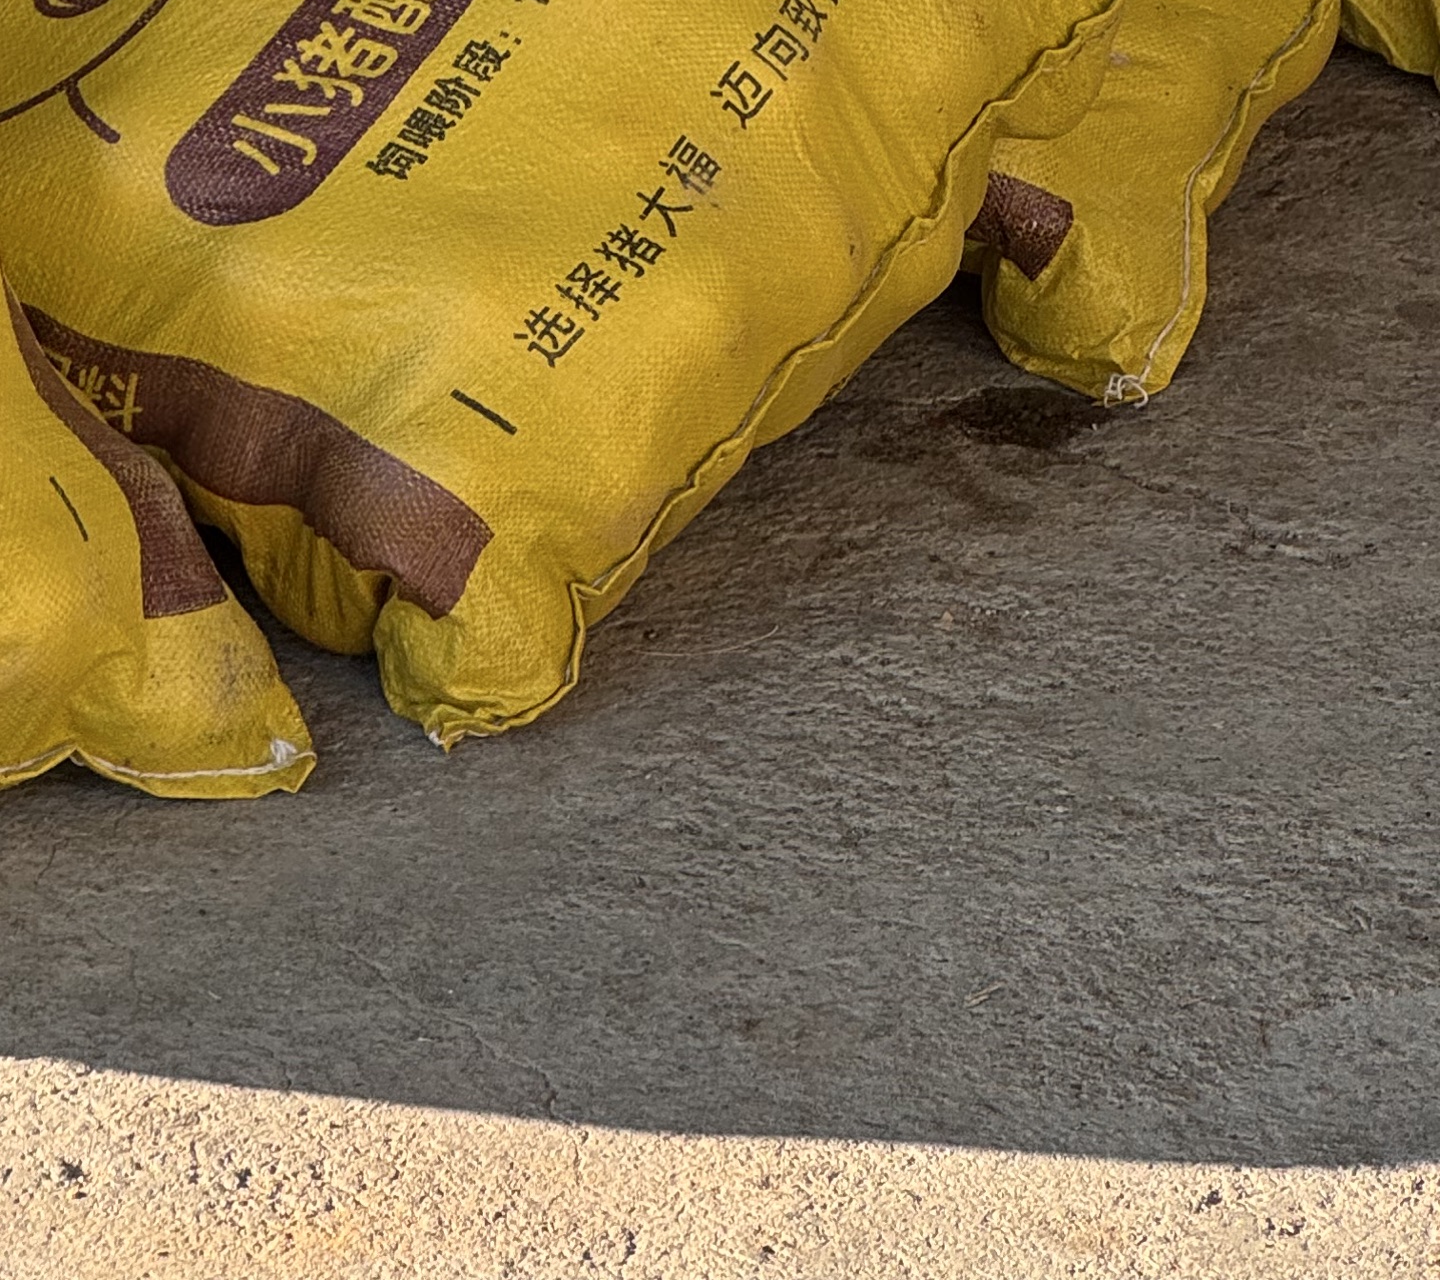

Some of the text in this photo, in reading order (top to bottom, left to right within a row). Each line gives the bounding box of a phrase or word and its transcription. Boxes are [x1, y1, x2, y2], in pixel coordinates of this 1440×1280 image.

[366, 30, 523, 182] 饲喂阶段：
[513, 134, 725, 369] 选择猪大福
